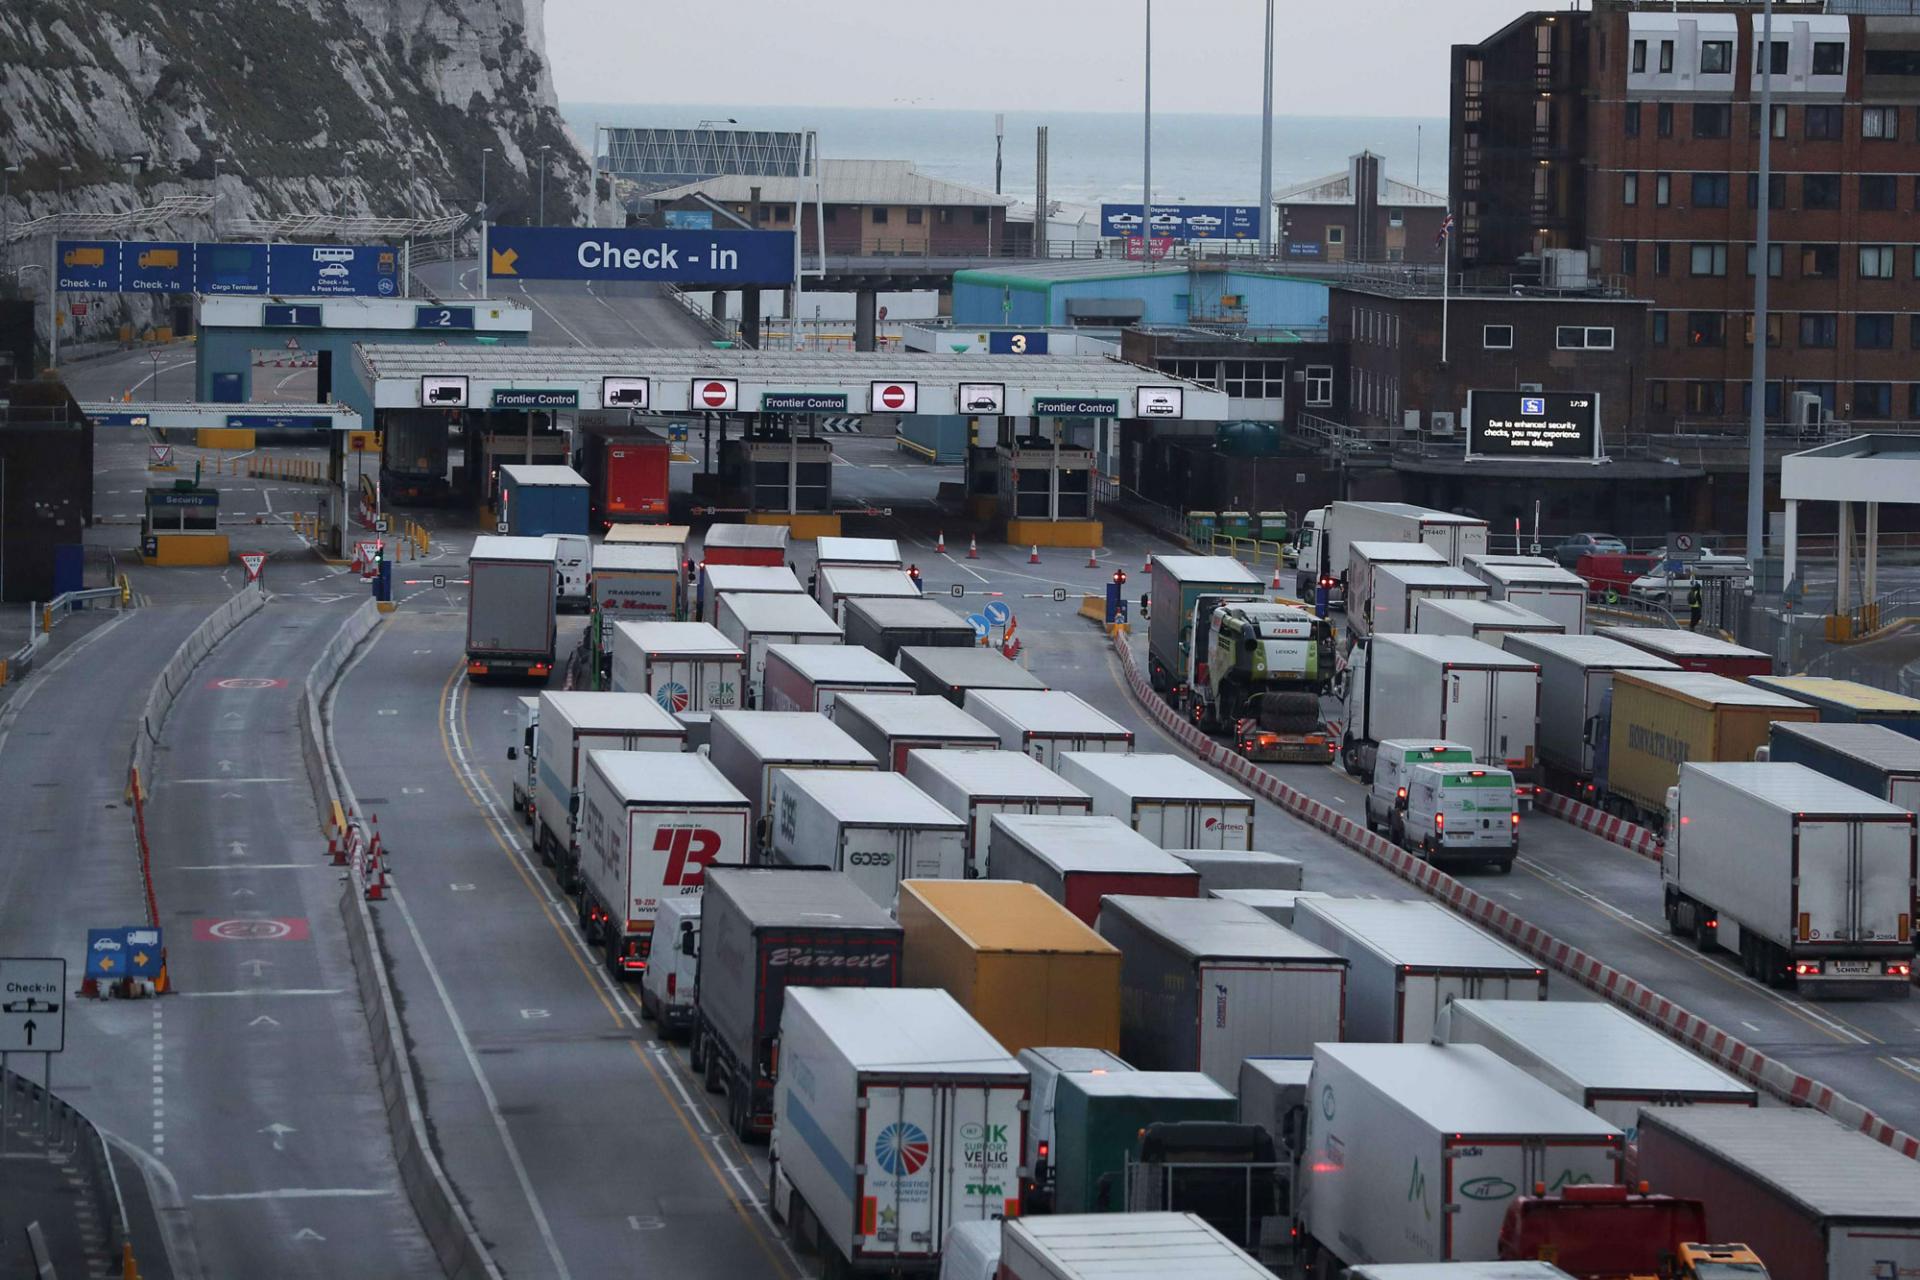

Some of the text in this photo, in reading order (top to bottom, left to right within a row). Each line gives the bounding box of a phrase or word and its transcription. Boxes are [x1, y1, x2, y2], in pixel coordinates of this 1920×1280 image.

[577, 241, 679, 270] Check
[710, 243, 738, 270] in
[60, 278, 90, 288] Check
[98, 279, 108, 288] In
[132, 279, 163, 289] Check
[171, 281, 180, 289] In
[211, 283, 231, 291] Cargo
[289, 308, 297, 324] 1
[439, 310, 451, 326] 2
[1011, 334, 1027, 353] 3
[496, 394, 576, 405] Frontier Control
[766, 398, 845, 409] Frontier Control
[1037, 402, 1116, 413] Frontier Control
[1489, 420, 1576, 430] Due to enhanced security
[1484, 429, 1510, 438] checks,
[1526, 431, 1541, 439] may
[1543, 430, 1580, 439] experience
[1531, 439, 1554, 448] delays
[166, 495, 204, 505] Security
[708, 697, 735, 705] VELIG
[6, 982, 57, 993] Check-in
[964, 1151, 1008, 1163] VELIG
